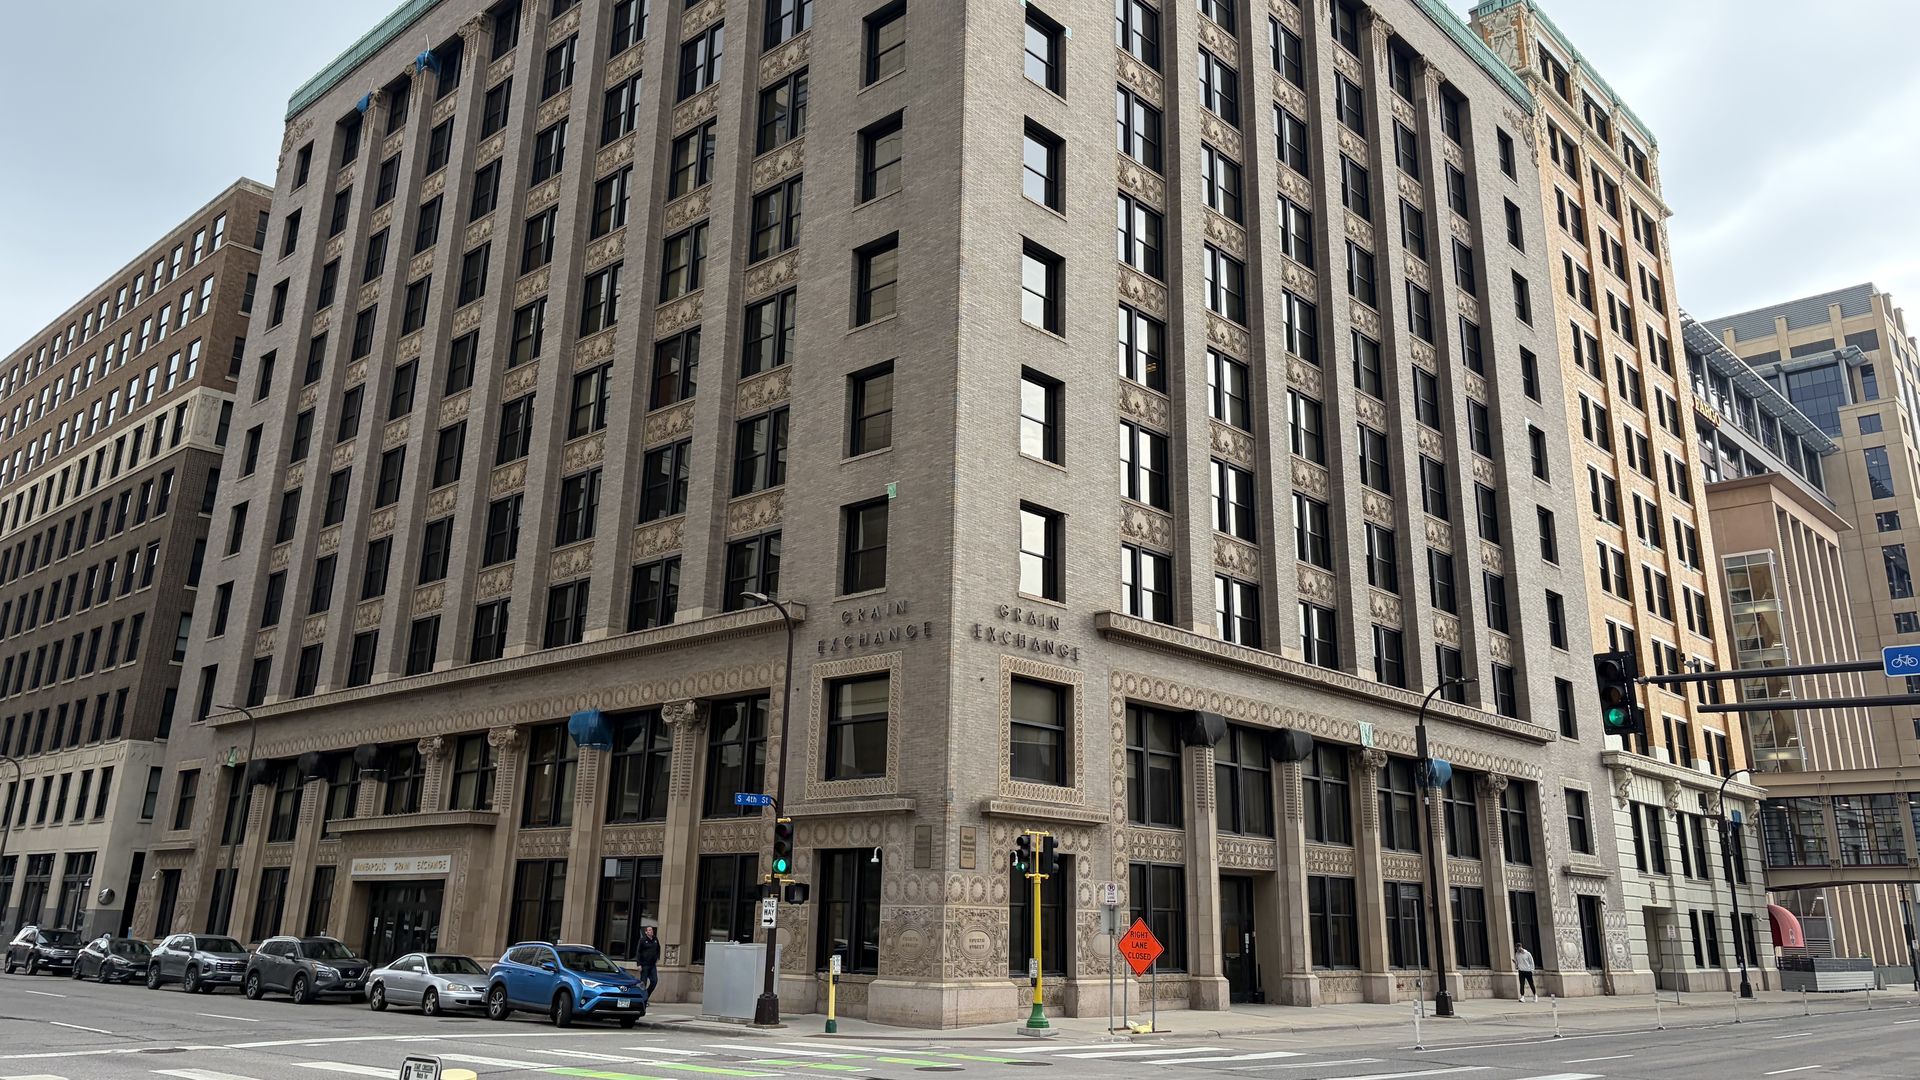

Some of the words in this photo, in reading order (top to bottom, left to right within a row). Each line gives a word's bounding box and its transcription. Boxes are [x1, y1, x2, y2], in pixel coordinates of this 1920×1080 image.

[841, 600, 907, 625] GRAIN
[1000, 604, 1060, 626] GRAIN
[817, 621, 933, 656] EXCHANGE
[974, 623, 1081, 662] EXCHANGE
[737, 794, 742, 803] S
[746, 795, 757, 804] 4th
[761, 796, 769, 804] St
[764, 900, 775, 908] ONE
[764, 908, 775, 916] WAY
[1130, 930, 1148, 939] RIGHT
[1131, 941, 1148, 950] LANE
[1127, 951, 1152, 961] CLOSED
